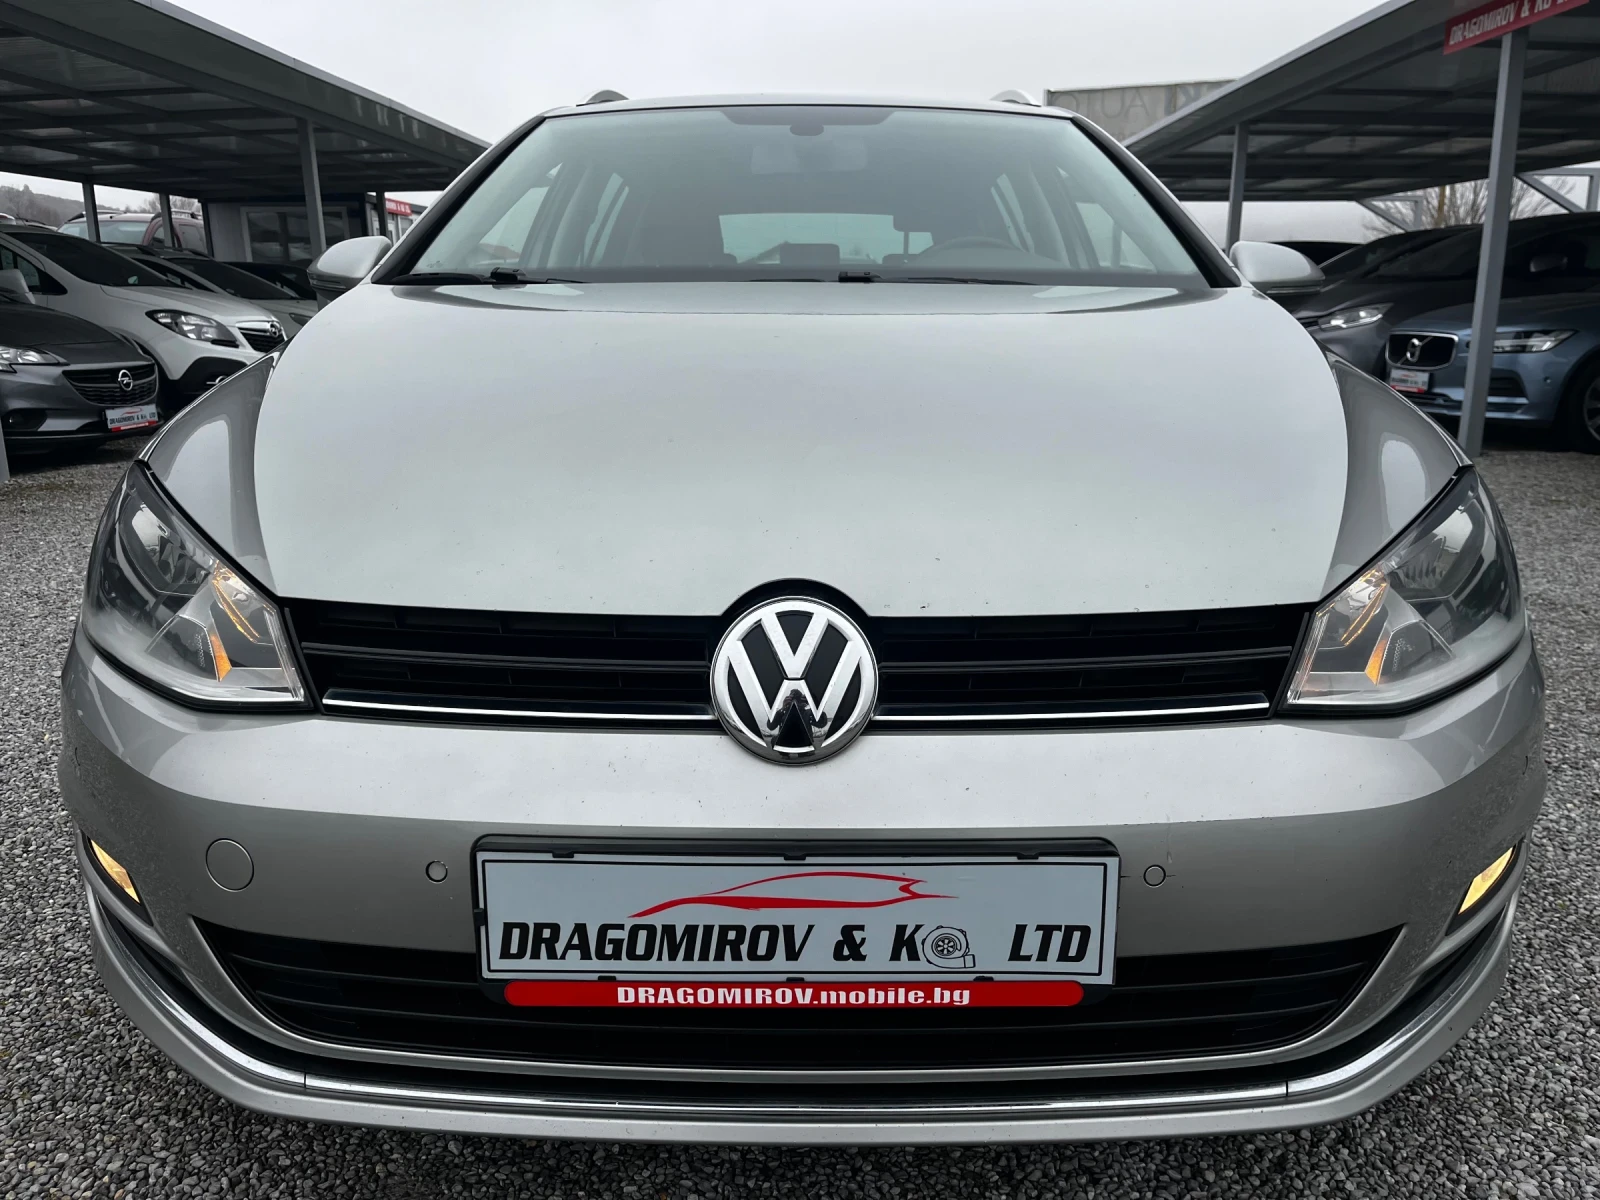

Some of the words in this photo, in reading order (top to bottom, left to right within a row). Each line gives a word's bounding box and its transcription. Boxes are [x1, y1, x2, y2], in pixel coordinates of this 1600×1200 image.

[1449, 1, 1519, 45] DRAGOMIROV
[499, 922, 815, 962] DRAGOMIROV
[832, 924, 868, 962] &
[1008, 923, 1092, 963] LTD
[617, 986, 971, 1006] DRAGOMIROV.mobile.bg
